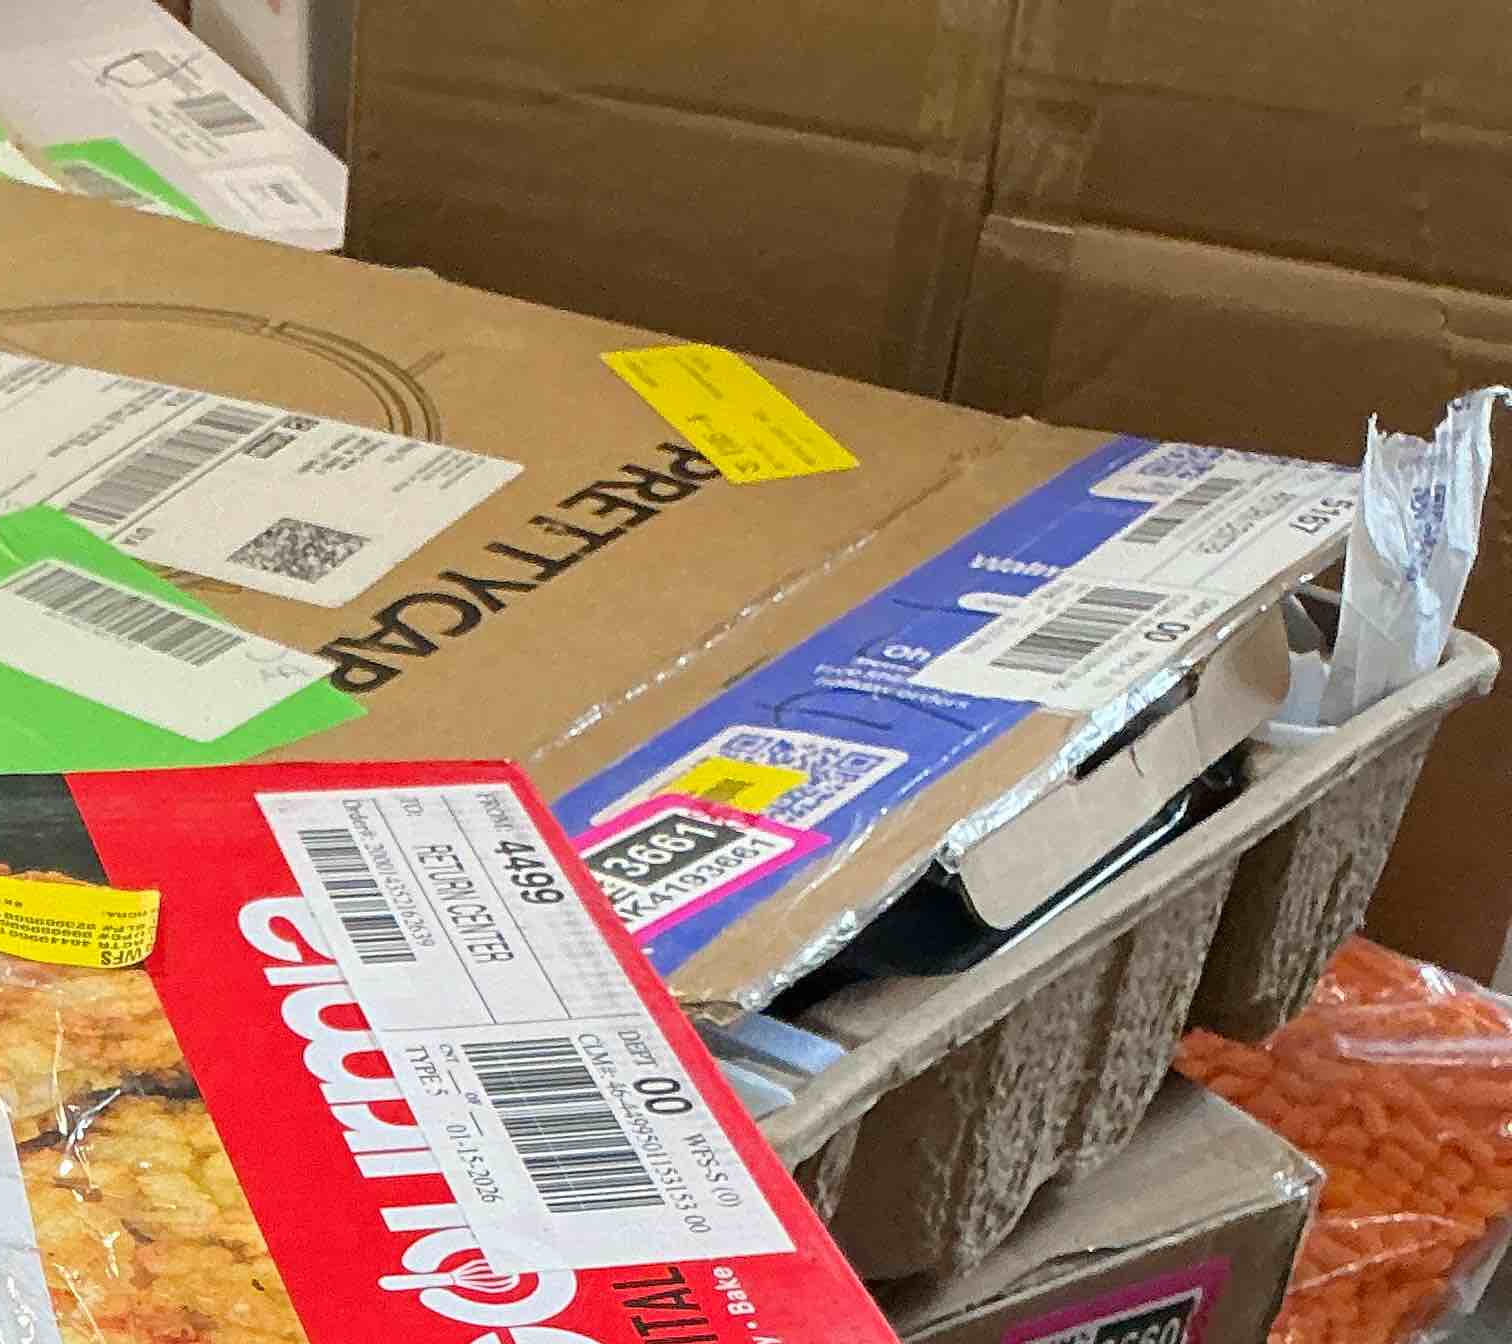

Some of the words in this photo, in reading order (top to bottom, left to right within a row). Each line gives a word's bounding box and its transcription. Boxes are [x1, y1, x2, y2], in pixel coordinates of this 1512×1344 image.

[399, 797, 423, 817] TO:
[418, 844, 478, 901] RETURN
[476, 792, 514, 832] FROM:
[495, 841, 564, 904] 4499
[602, 821, 719, 881] 3661
[101, 949, 142, 966] WFS
[447, 904, 514, 963] CENTER
[617, 1030, 658, 1067] DEPT
[633, 1077, 693, 1115] 00
[446, 1124, 503, 1203] 01-15-2026
[683, 1133, 729, 1182] WFS-S
[711, 1187, 742, 1208] (0)
[684, 1215, 712, 1234] 00
[713, 1266, 755, 1316] Bake
